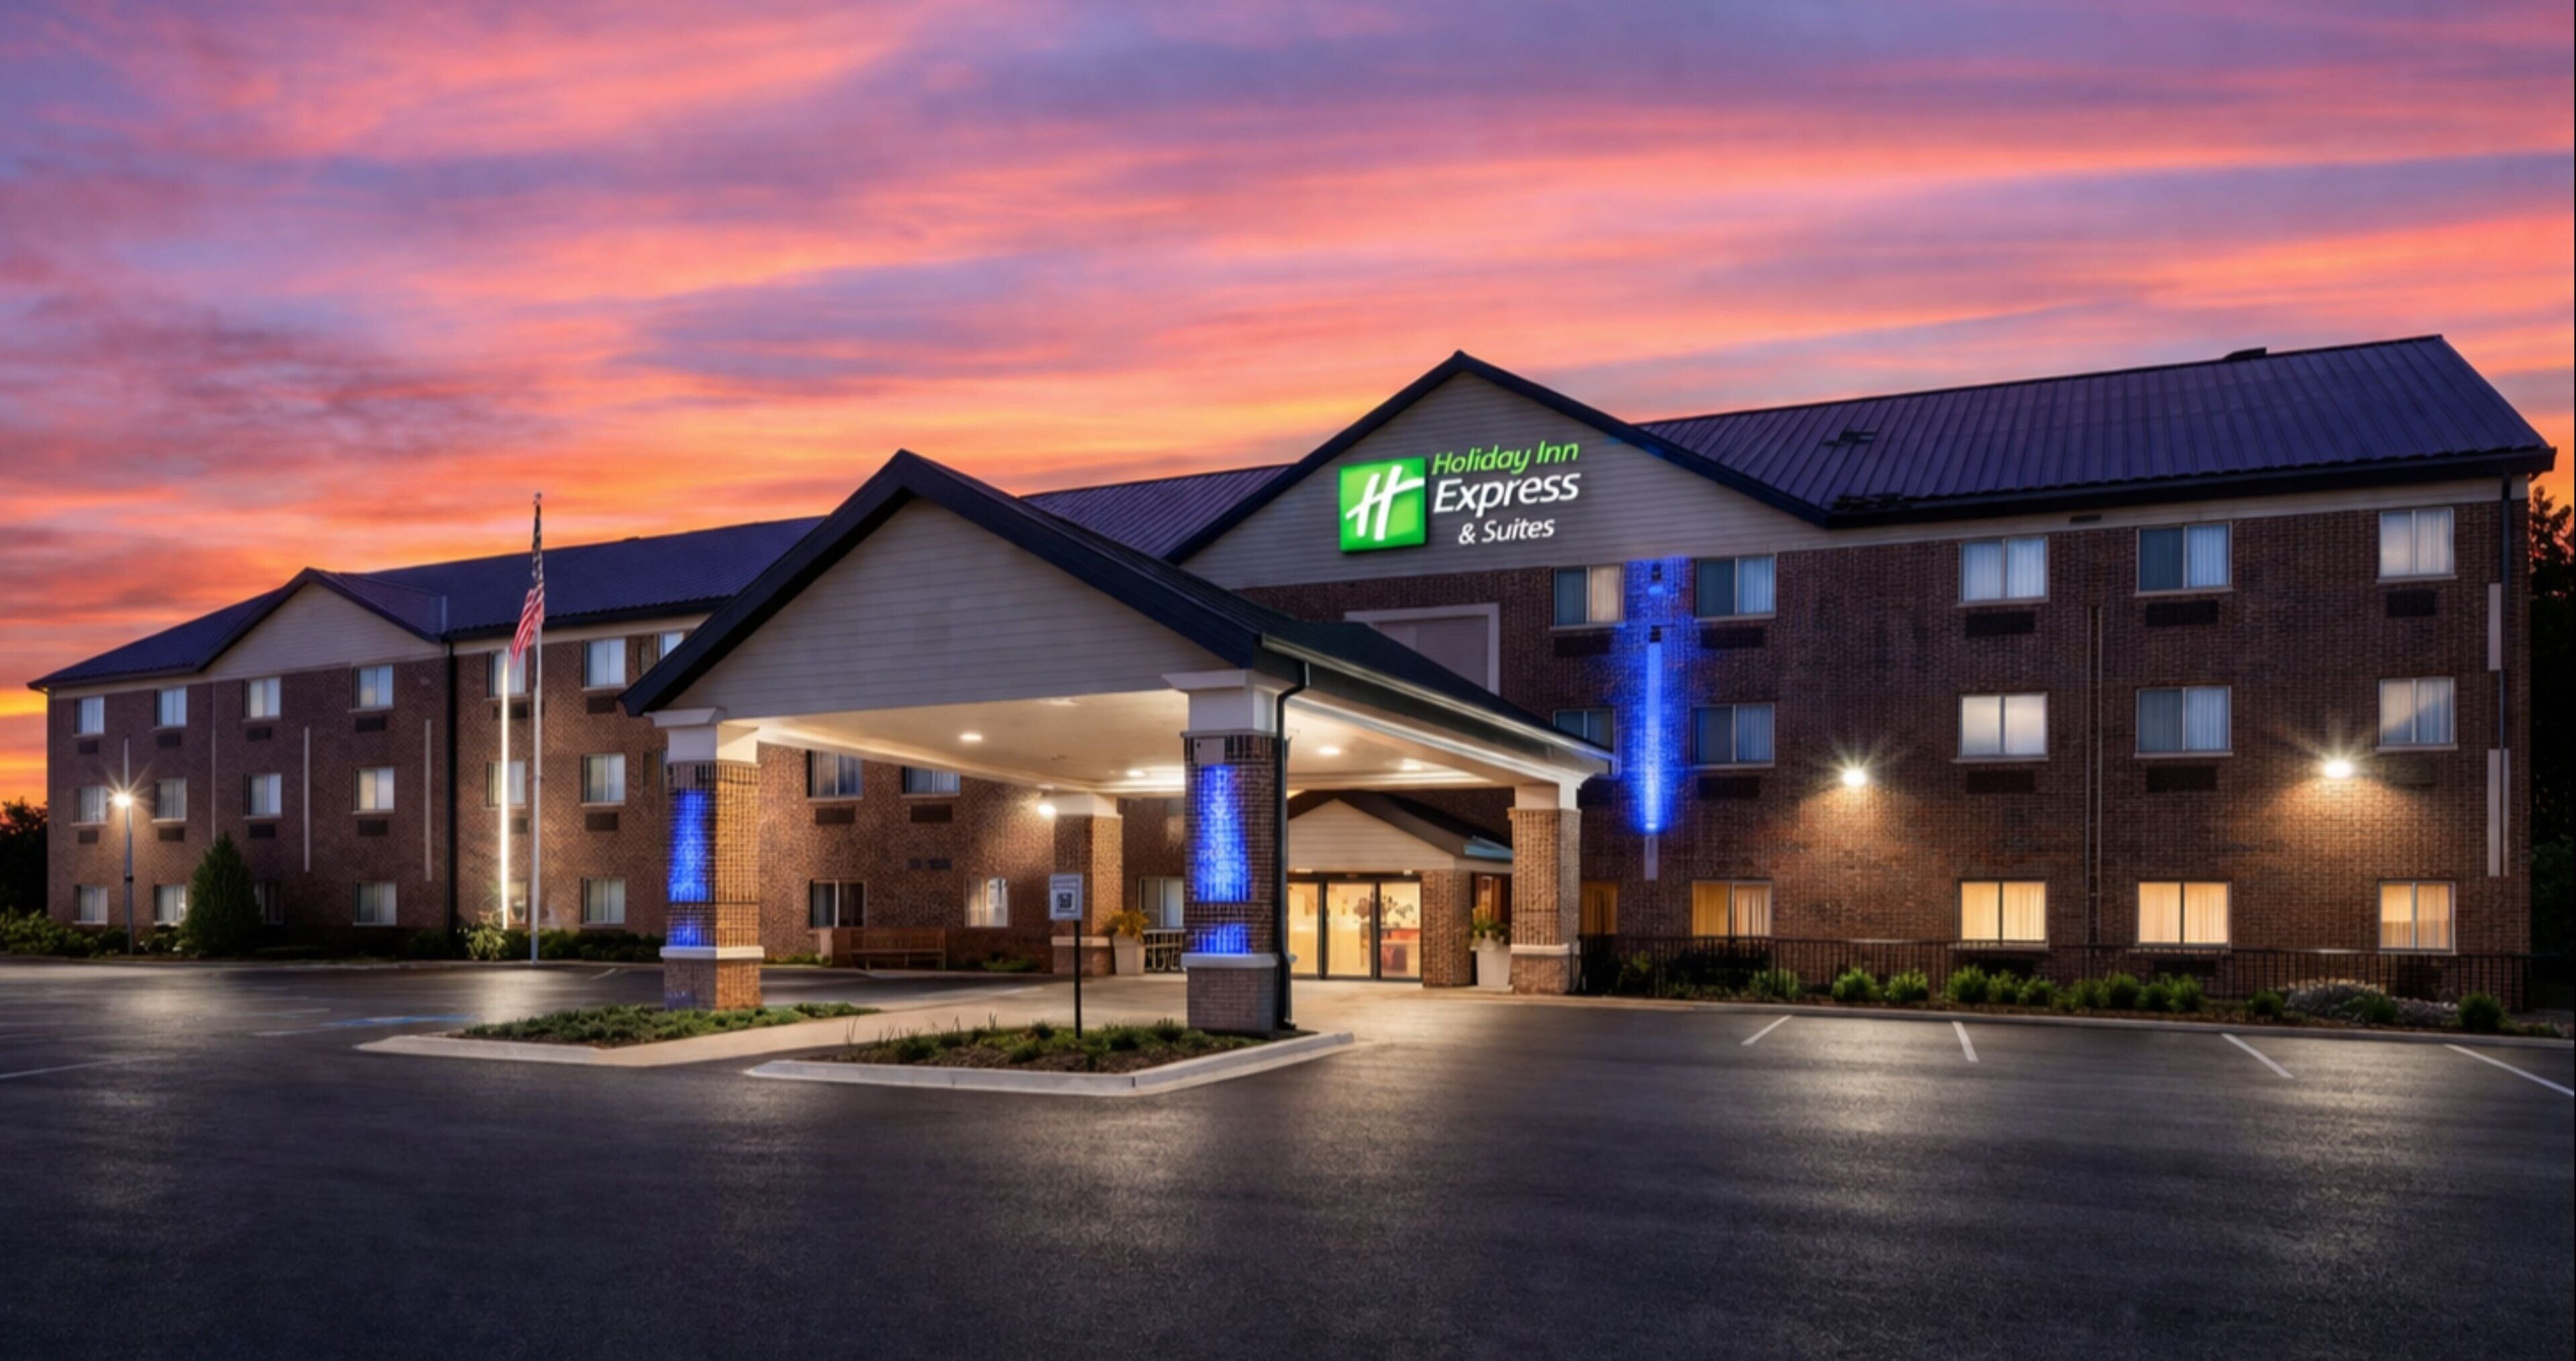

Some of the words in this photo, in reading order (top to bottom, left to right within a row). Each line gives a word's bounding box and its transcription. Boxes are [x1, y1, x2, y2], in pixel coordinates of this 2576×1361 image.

[1432, 445, 1531, 475] Holiday
[1536, 440, 1579, 464] Inn
[1433, 472, 1581, 518] Express
[1458, 523, 1475, 545] &
[1481, 517, 1556, 543] Suites
